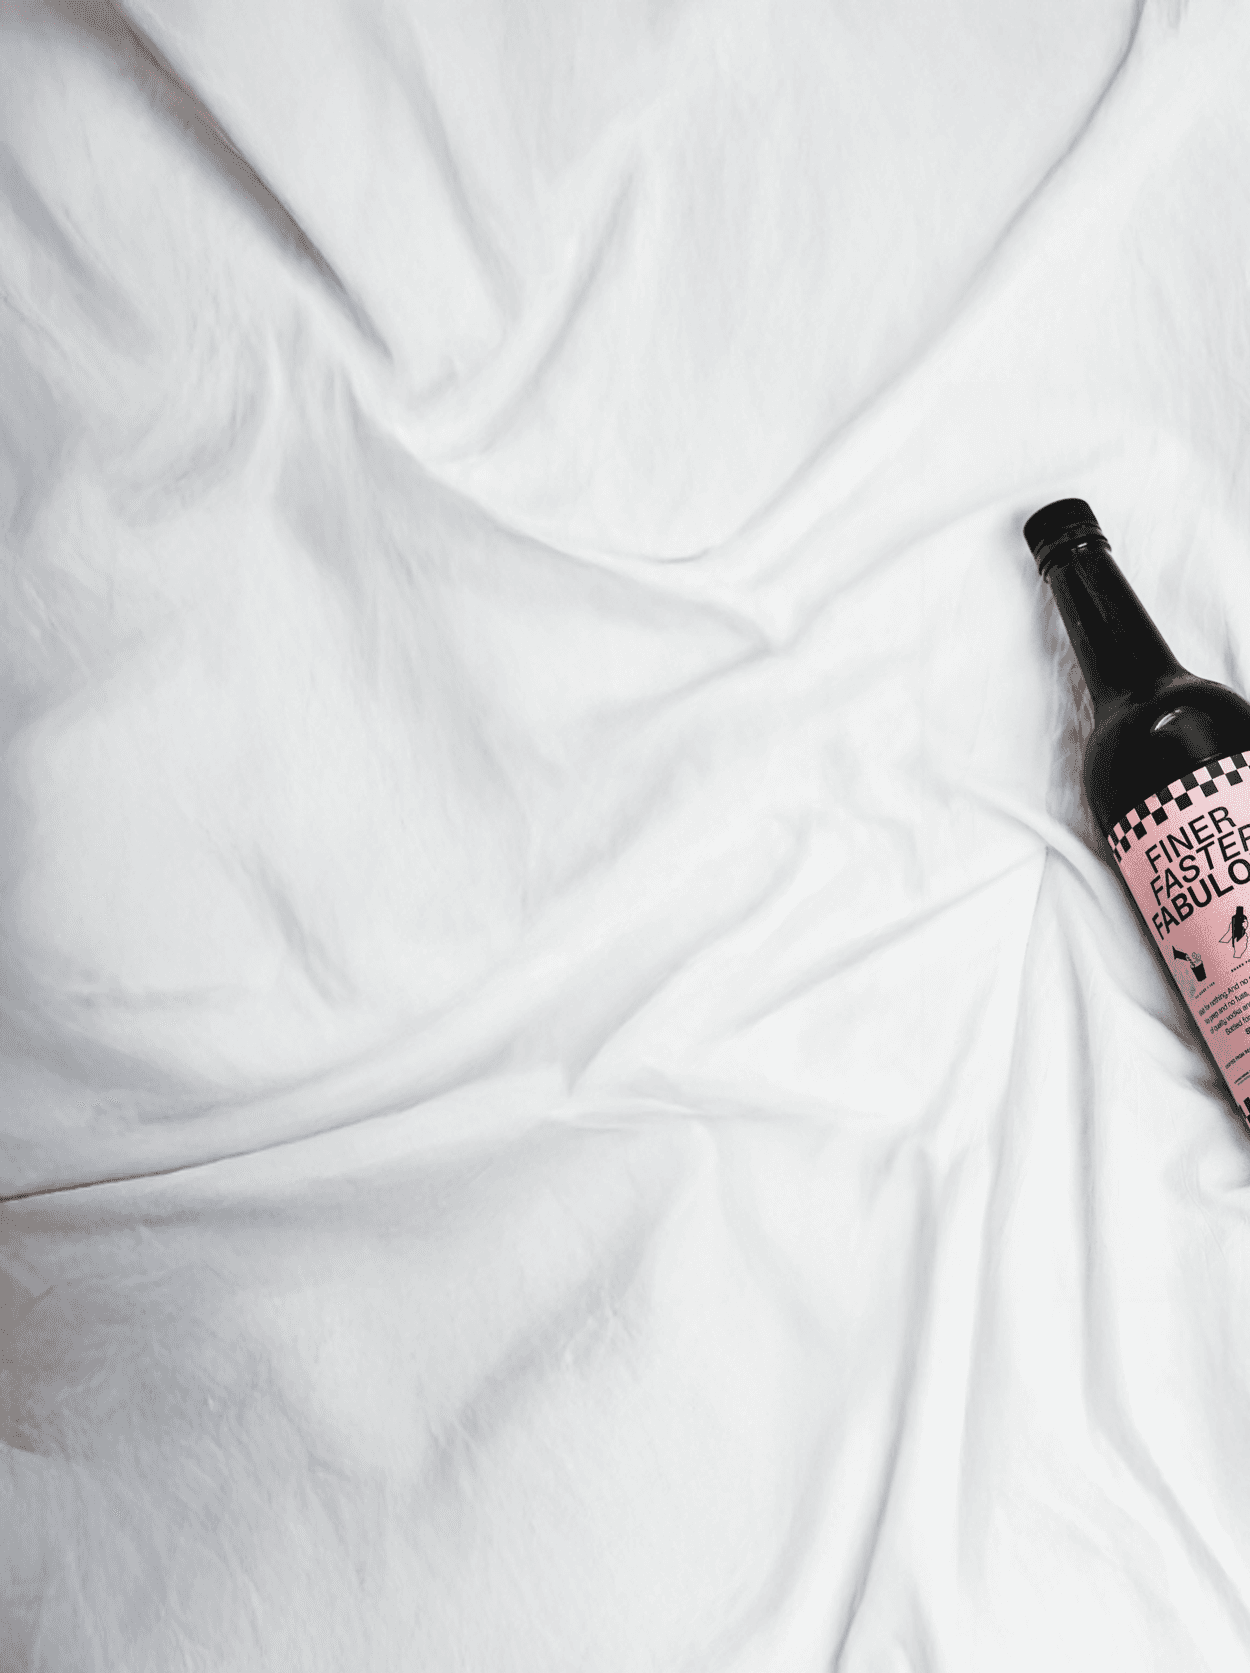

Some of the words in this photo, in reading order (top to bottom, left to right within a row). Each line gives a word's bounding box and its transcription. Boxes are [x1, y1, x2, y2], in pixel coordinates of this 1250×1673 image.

[1144, 806, 1237, 874] FINER
[1228, 983, 1240, 994] And
[1240, 978, 1249, 986] no
[1218, 1003, 1228, 1014] and
[1226, 1008, 1242, 1021] vodka
[1224, 1020, 1243, 1035] Bottled
[1242, 1015, 1250, 1023] for
